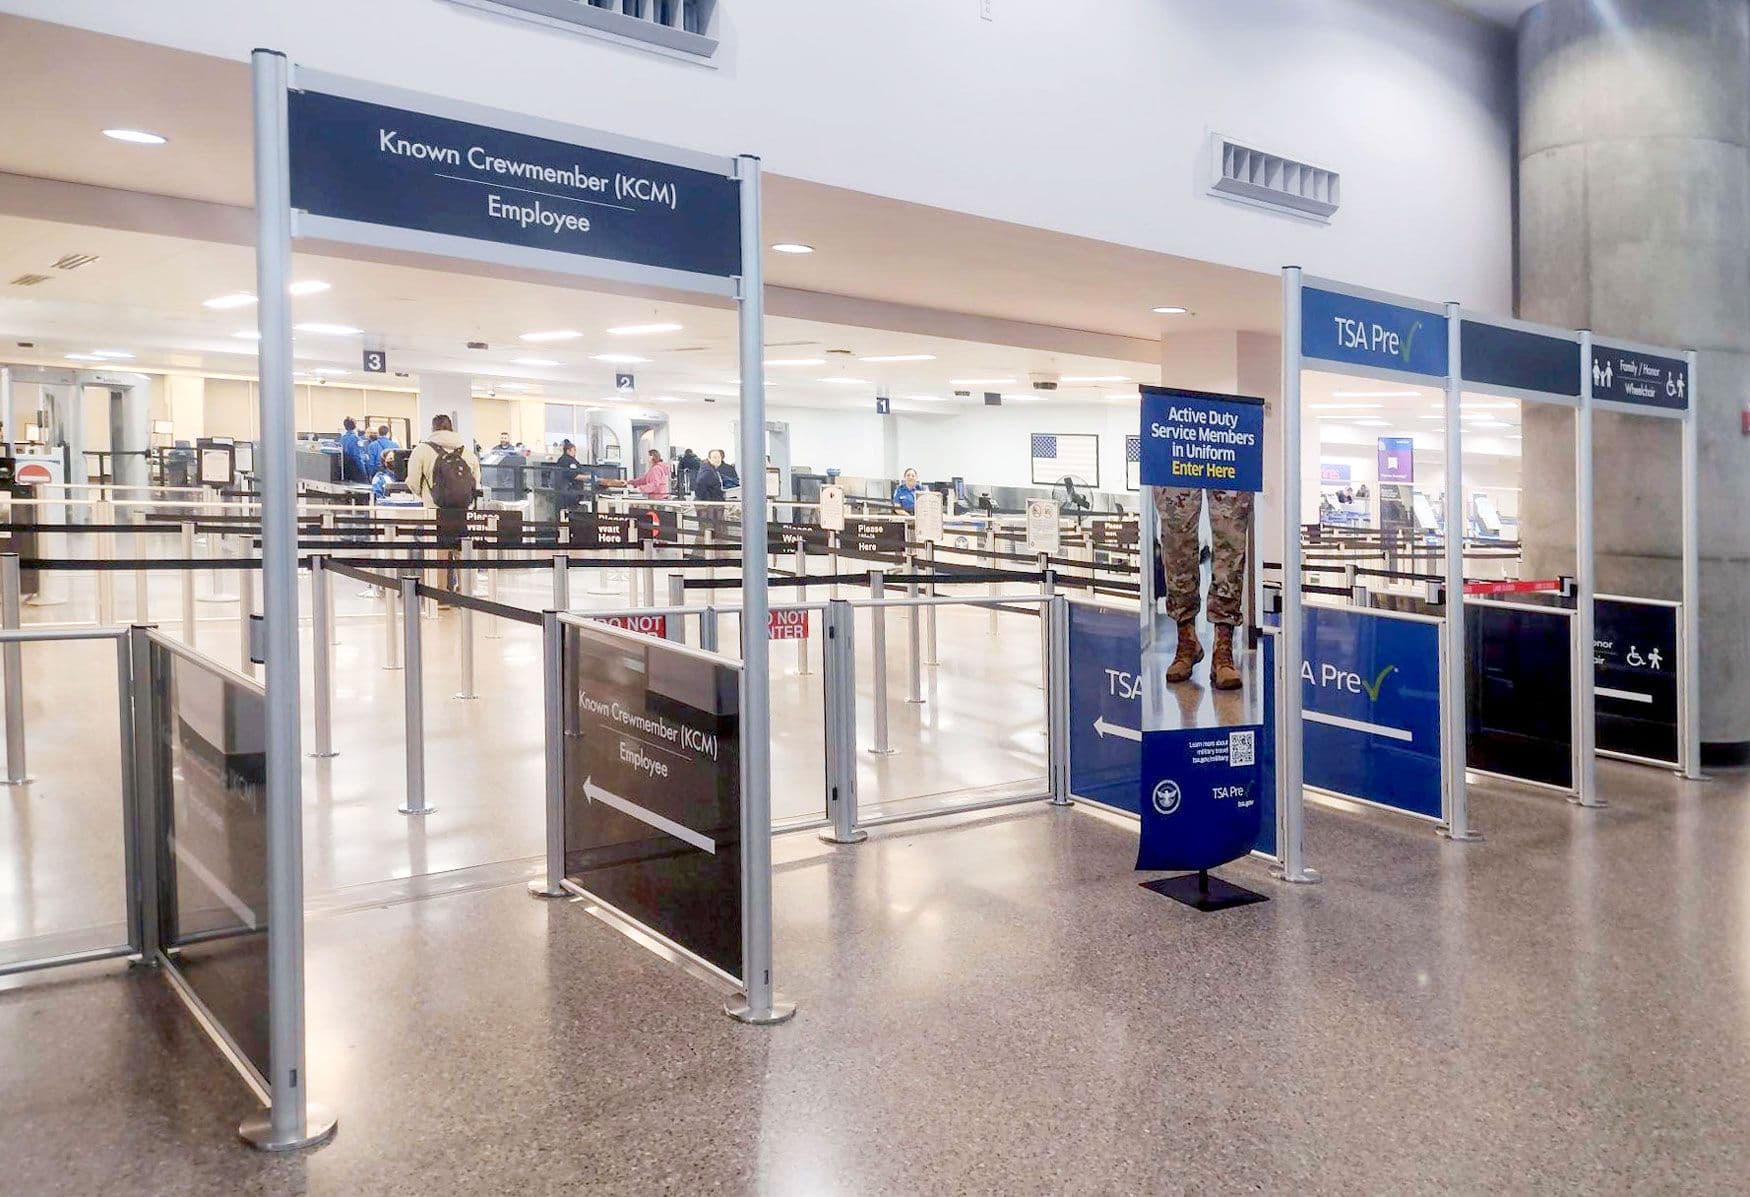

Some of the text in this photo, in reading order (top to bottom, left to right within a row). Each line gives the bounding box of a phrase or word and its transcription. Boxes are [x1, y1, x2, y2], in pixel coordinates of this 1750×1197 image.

[379, 128, 677, 210] Known Crewmember (KCM)
[488, 194, 591, 233] Employee
[1335, 316, 1399, 355] TSA Pre
[368, 354, 381, 370] 3
[1620, 359, 1638, 376] Family
[620, 376, 634, 391] 2
[1625, 382, 1655, 397] Wheelchair
[1168, 406, 1238, 429] Active Duty
[1151, 423, 1255, 445] Service Members
[1172, 442, 1235, 461] in Uniform
[1172, 461, 1236, 479] Enter Here
[857, 524, 884, 534] Please
[598, 533, 621, 543] Here
[858, 542, 877, 551] Here
[627, 615, 663, 631] NOT
[777, 610, 807, 625] NOT
[768, 625, 804, 639] NTER
[1104, 668, 1142, 700] TSA
[1322, 663, 1361, 694] Pre
[578, 690, 718, 761] Known Crewmember (KCM)
[619, 741, 668, 777] Employee
[1212, 786, 1244, 799] TSA Pre
